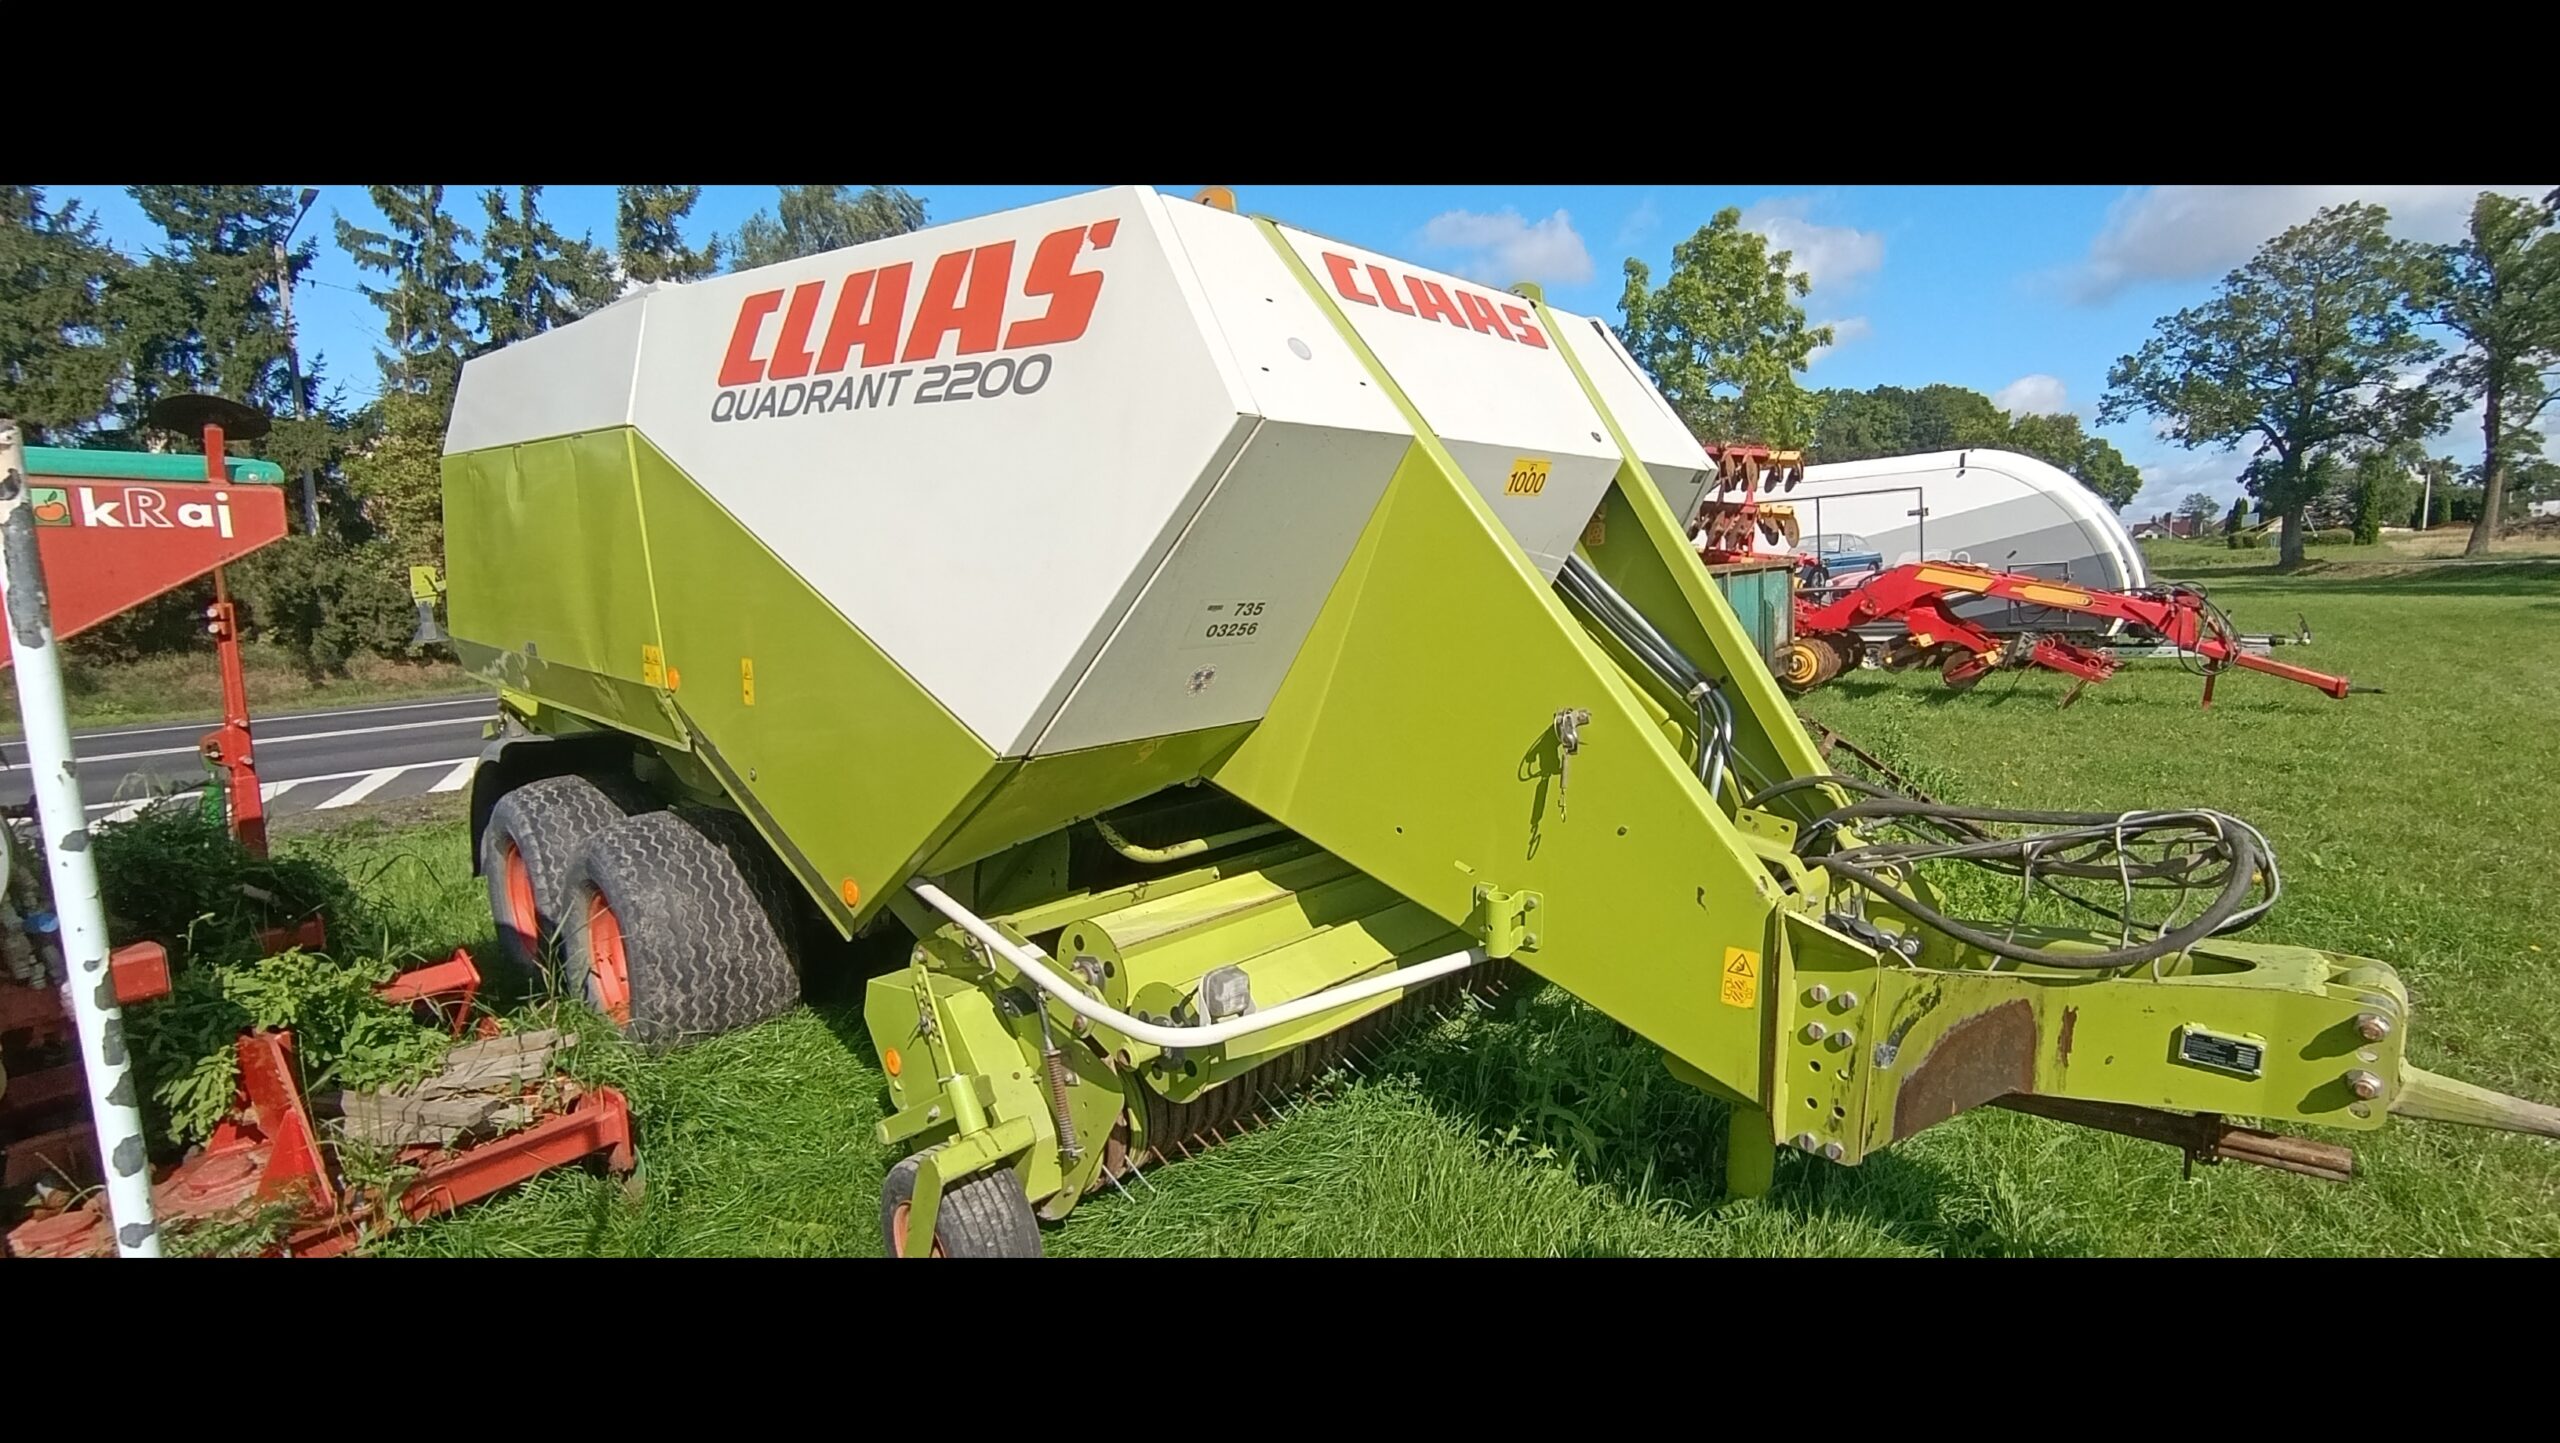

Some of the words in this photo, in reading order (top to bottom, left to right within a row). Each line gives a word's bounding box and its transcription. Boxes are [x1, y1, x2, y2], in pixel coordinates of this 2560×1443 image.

[718, 218, 1121, 387] CLAAS
[1321, 251, 1549, 350] CLAAS
[711, 369, 912, 423] QUADRANT
[913, 353, 1052, 404] 2200
[1508, 471, 1546, 493] 1000
[1206, 622, 1258, 637] 03256
[1234, 602, 1265, 616] 735
